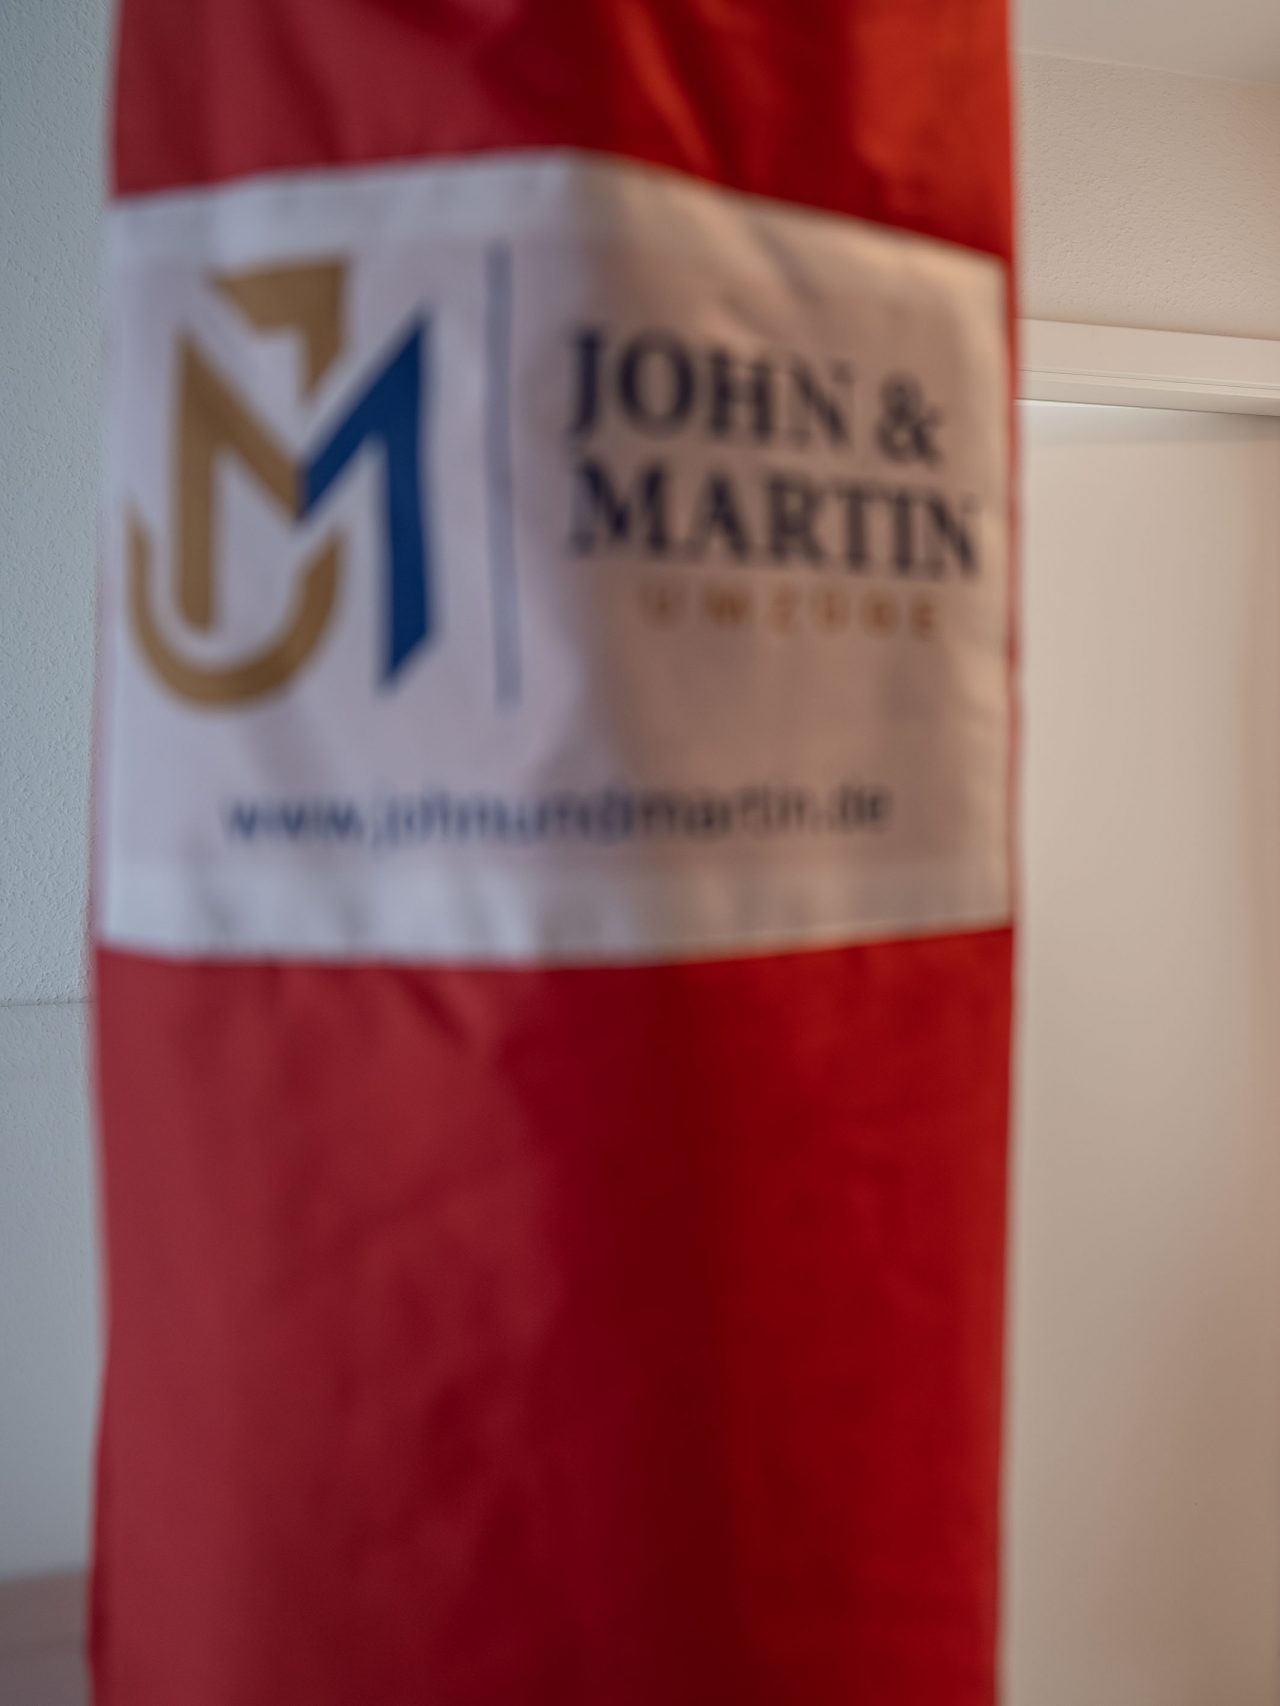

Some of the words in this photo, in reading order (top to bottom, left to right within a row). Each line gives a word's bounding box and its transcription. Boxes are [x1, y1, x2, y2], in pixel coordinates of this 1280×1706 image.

[571, 326, 853, 446] JOHN
[876, 371, 941, 464] &
[570, 458, 979, 580] MARTIN
[221, 778, 895, 849] www.johnundmartin.de
